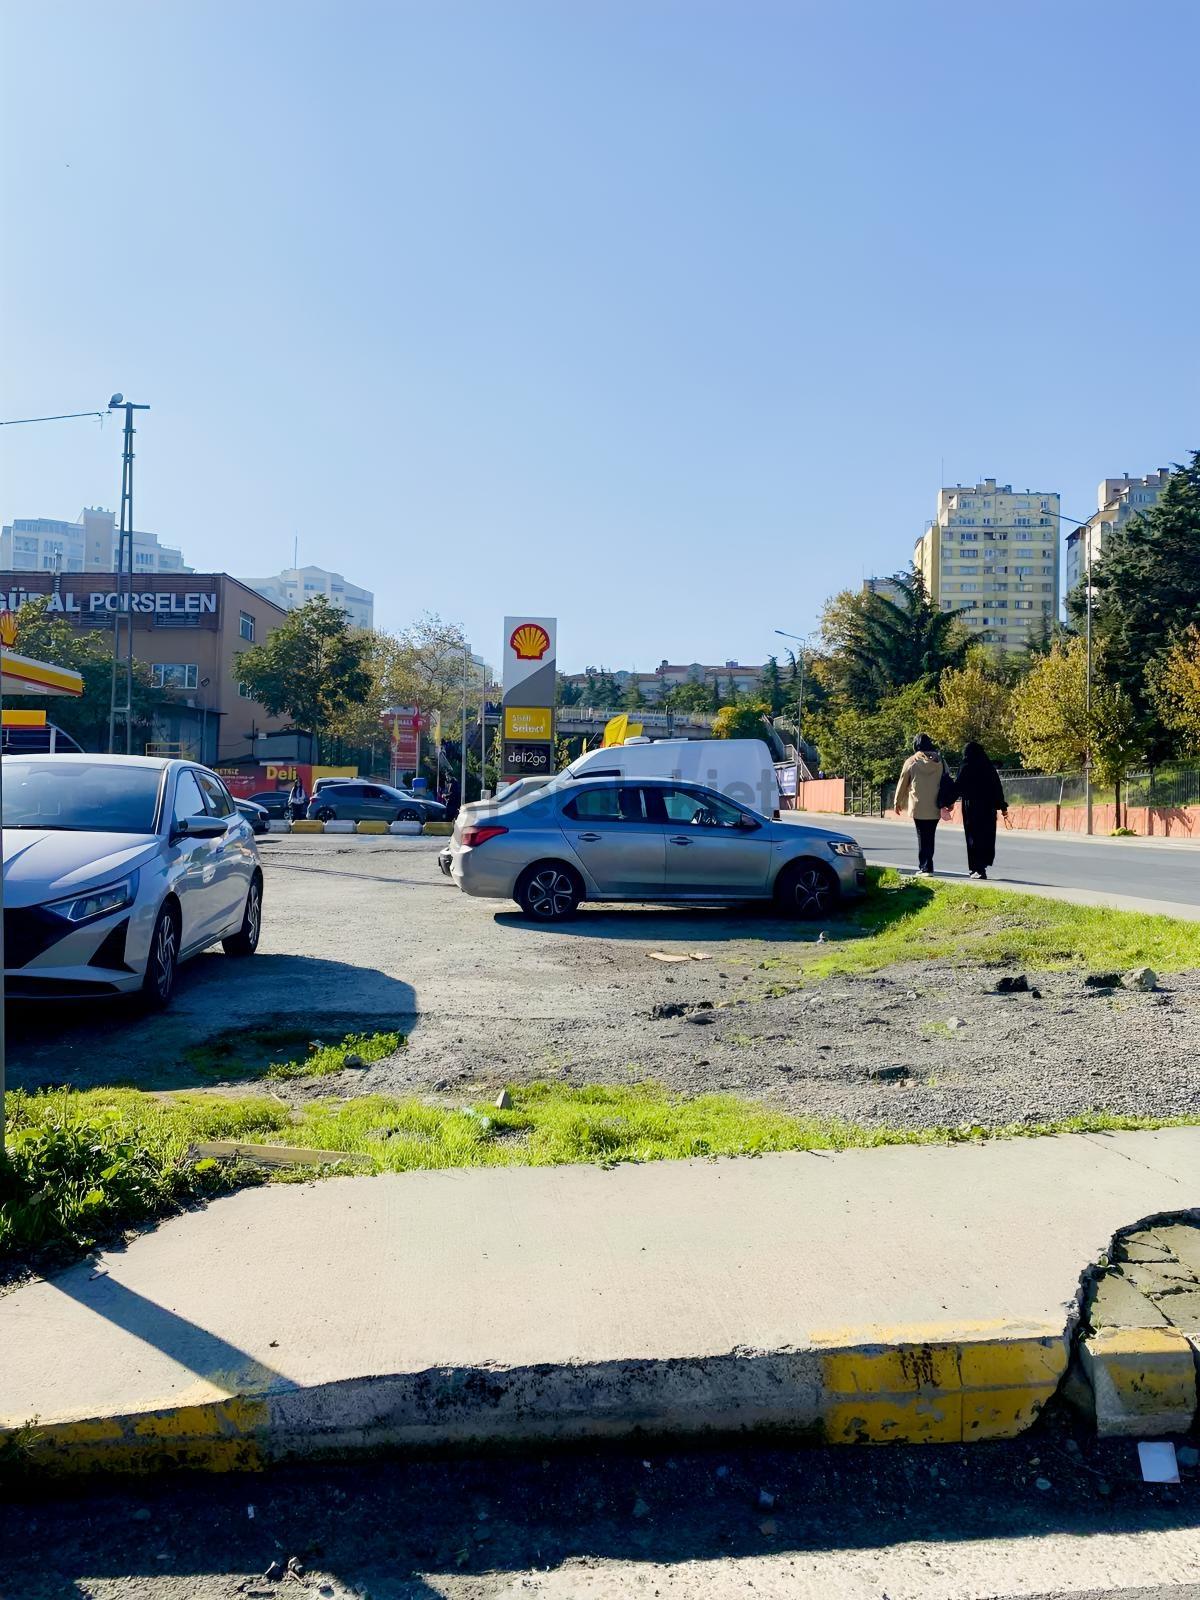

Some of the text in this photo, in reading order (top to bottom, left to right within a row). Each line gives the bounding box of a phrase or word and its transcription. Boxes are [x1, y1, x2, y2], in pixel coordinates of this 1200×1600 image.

[90, 593, 216, 612] PORSELEN
[508, 752, 546, 766] deli2go
[266, 766, 297, 780] Deli
